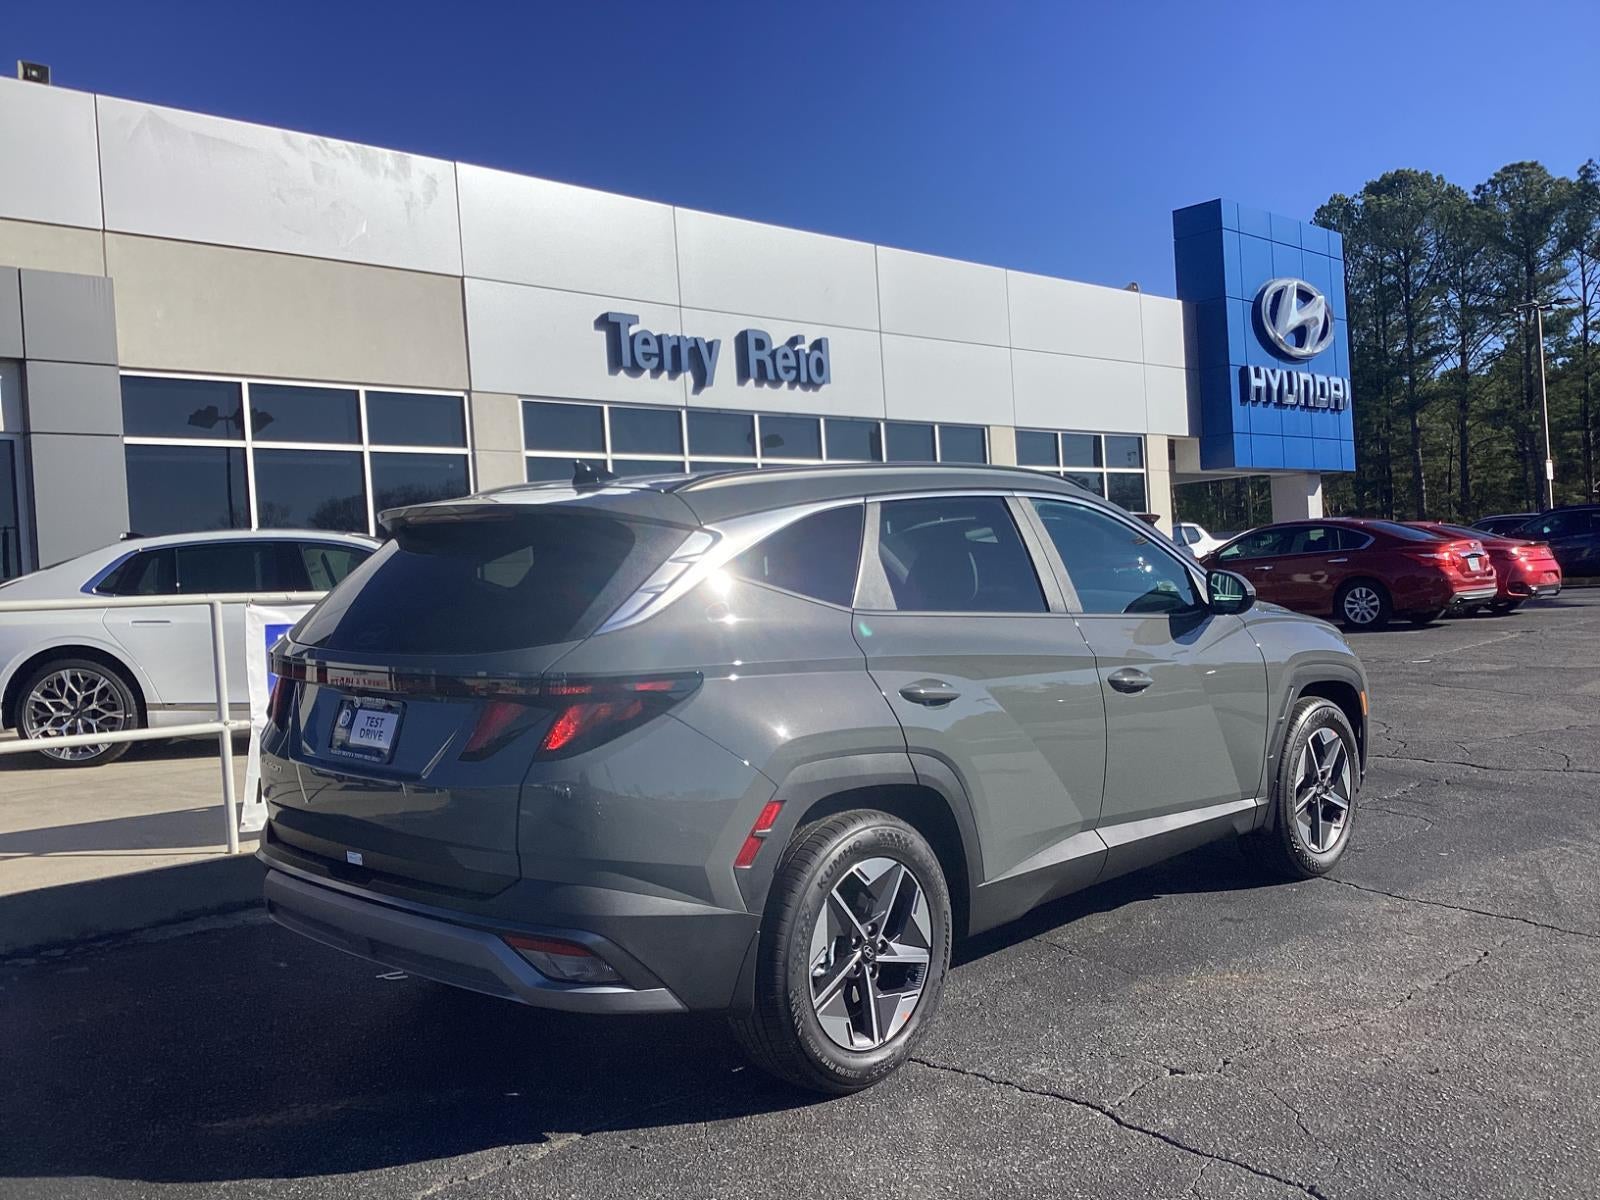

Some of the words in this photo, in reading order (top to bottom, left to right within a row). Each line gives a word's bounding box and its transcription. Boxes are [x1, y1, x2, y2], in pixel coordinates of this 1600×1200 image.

[595, 311, 721, 394] Terry
[735, 328, 831, 392] Reid
[1246, 365, 1351, 411] HYUNDAI
[360, 728, 383, 741] DRIVE
[365, 716, 384, 728] TEST
[817, 840, 862, 889] KUMHO
